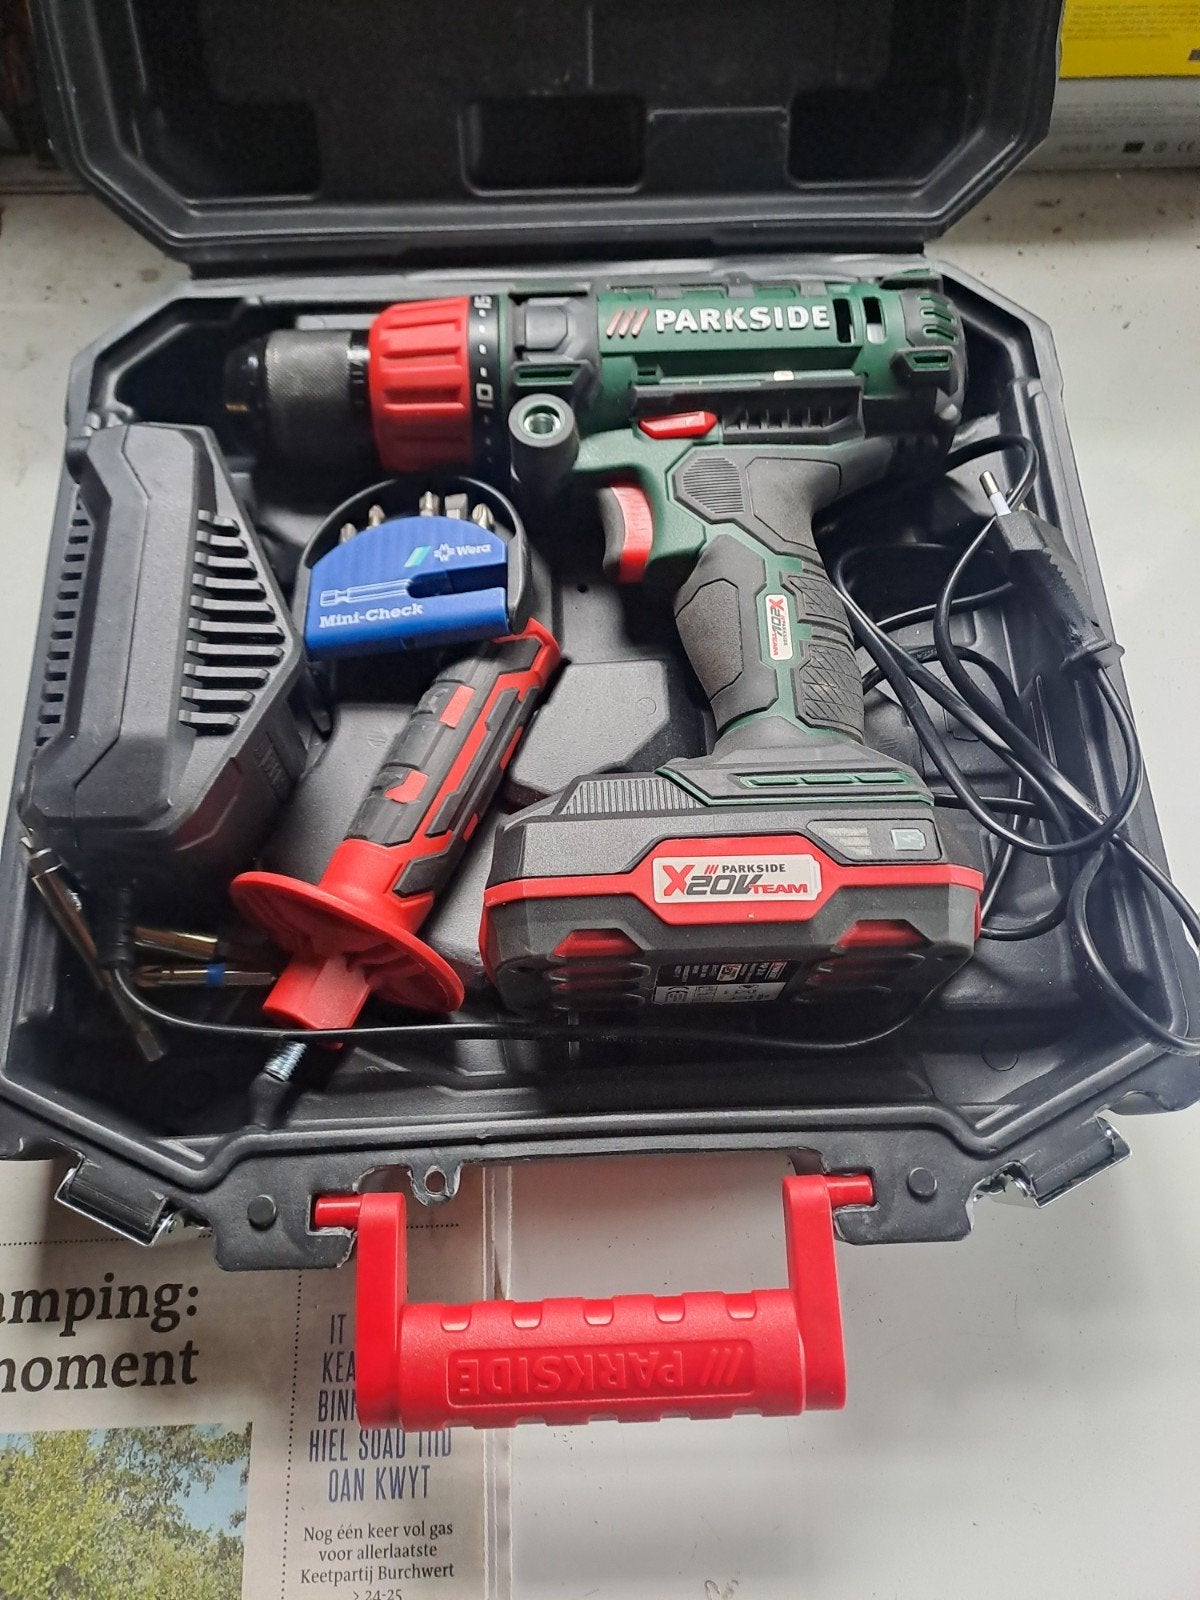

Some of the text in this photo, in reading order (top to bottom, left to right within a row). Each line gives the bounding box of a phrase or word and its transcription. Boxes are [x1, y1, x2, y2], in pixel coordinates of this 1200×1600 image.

[655, 305, 831, 333] PARKSIDE
[476, 382, 494, 408] 10
[456, 544, 491, 556] Wera
[319, 603, 424, 628] Mini-Check
[722, 864, 786, 873] PARKSIDE
[0, 1272, 199, 1337] mping:
[330, 1314, 347, 1345] IT
[458, 1350, 683, 1396] PARKSIDE
[309, 1428, 348, 1462] HIEL
[359, 1428, 405, 1460] SOAD
[329, 1465, 430, 1502] OAN KWYT
[304, 1521, 453, 1545] Nog één keer vol gas
[318, 1543, 437, 1561] voor allerlaatste
[300, 1563, 454, 1587] Keetpartij Burchwert
